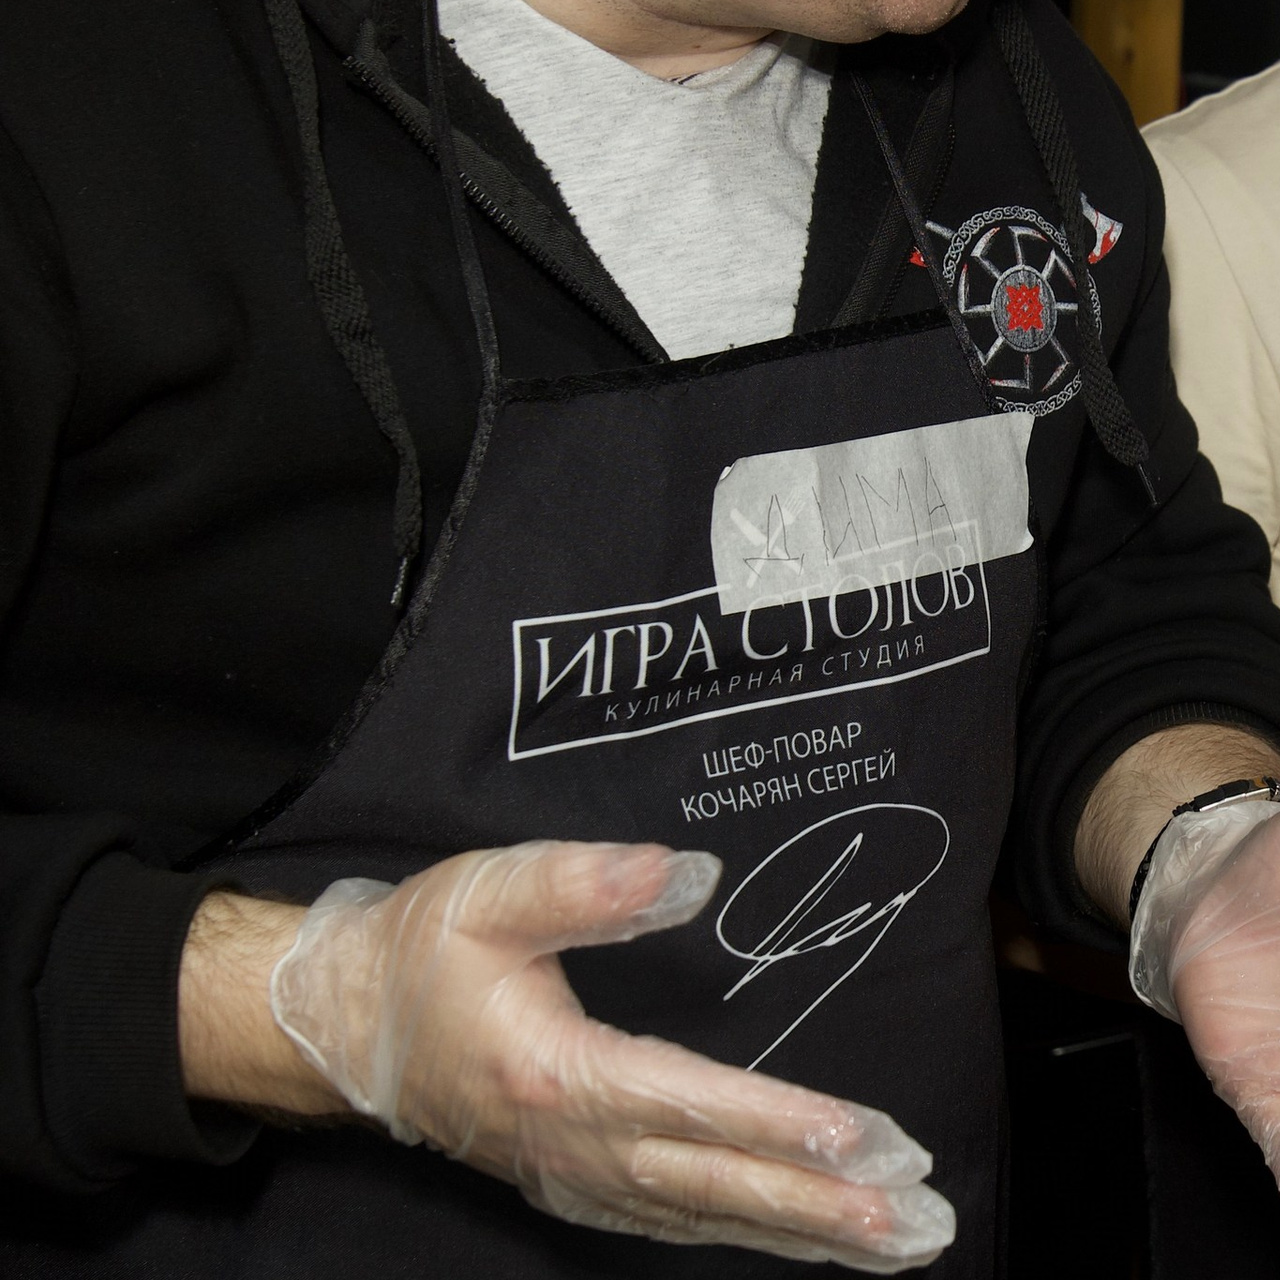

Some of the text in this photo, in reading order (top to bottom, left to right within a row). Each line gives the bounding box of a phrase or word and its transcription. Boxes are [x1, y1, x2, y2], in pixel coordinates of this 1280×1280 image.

[743, 456, 957, 578] ДИМА
[534, 543, 975, 704] ИГРА СТОЛОВ
[604, 634, 926, 723] КУЛИНАРНАЯ СТУДИЯ
[680, 748, 896, 822] КОЧАРЯН СЕРГЕЙ
[702, 721, 863, 779] ШЕФ-ПОВАР
